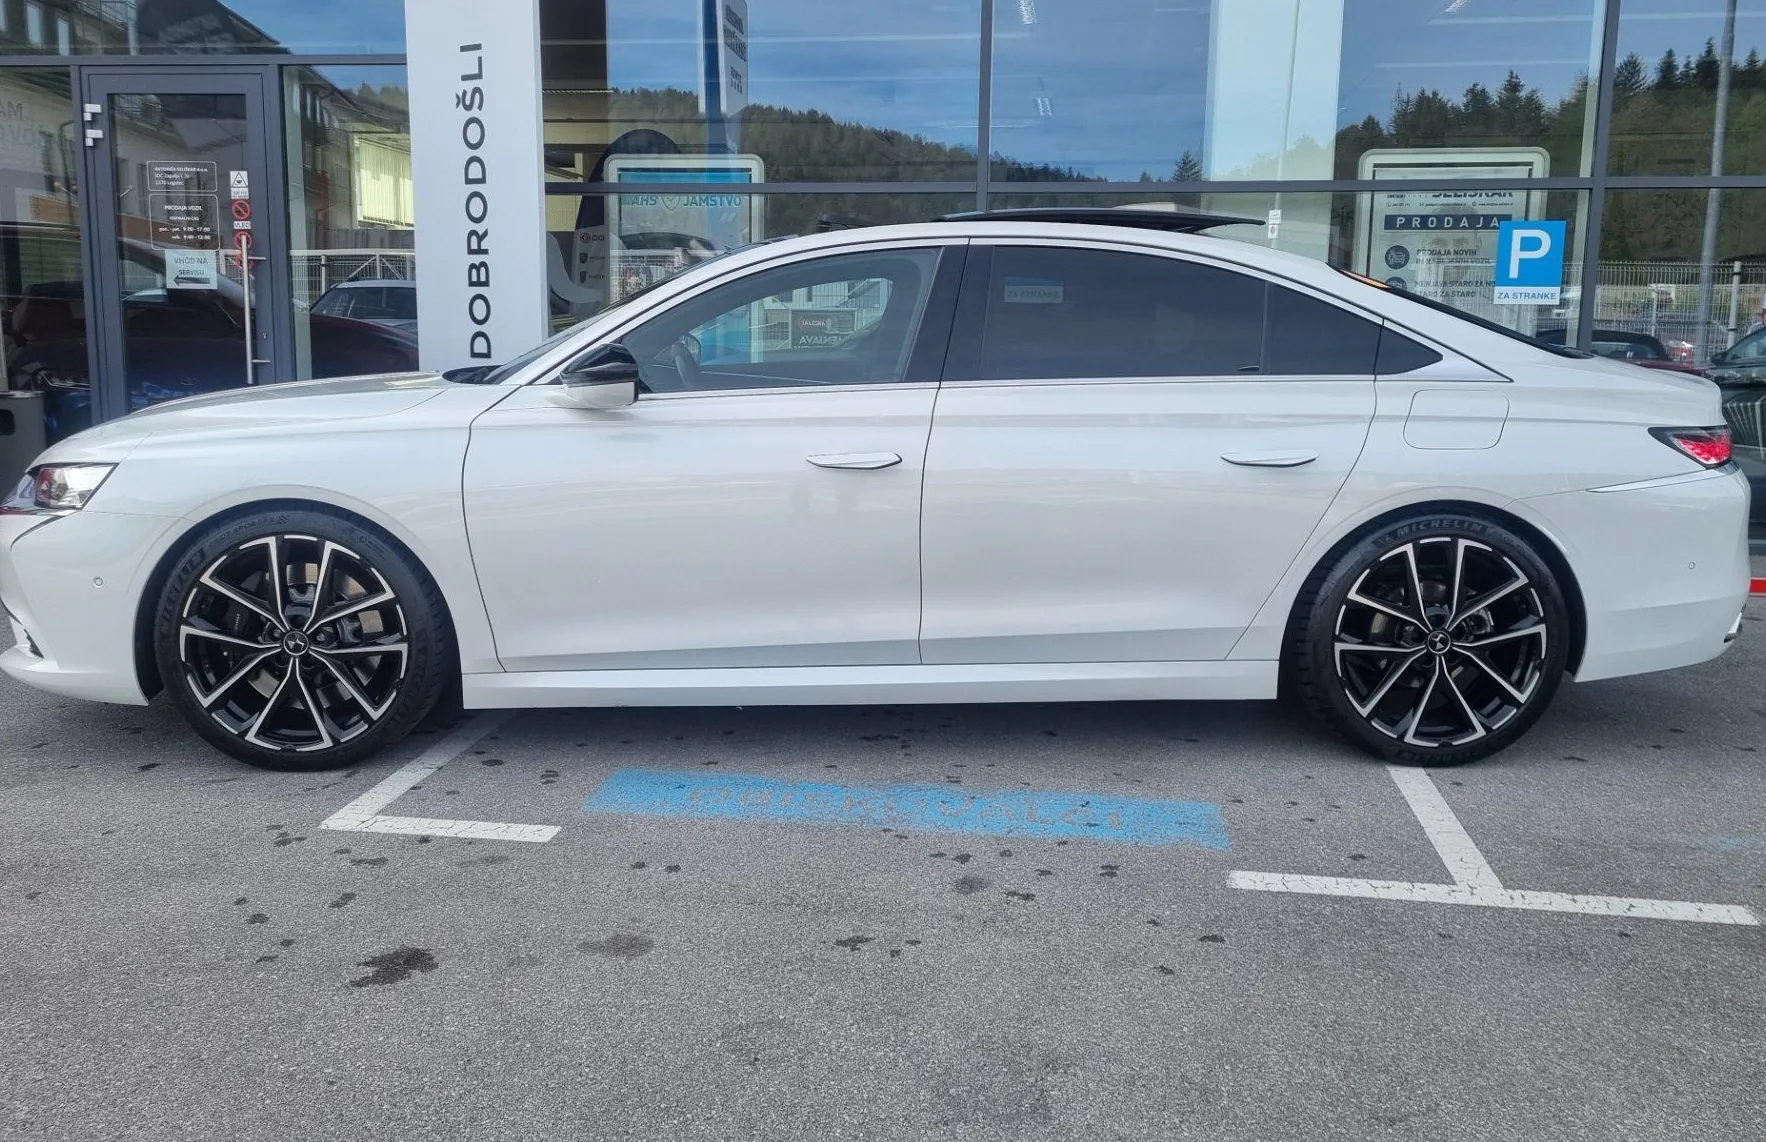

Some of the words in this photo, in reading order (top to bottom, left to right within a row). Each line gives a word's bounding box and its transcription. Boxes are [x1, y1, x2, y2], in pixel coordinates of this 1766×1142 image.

[456, 43, 492, 358] DOBRODOŠLI
[631, 195, 657, 206] AHS
[683, 195, 742, 207] JAMSTVO
[1397, 216, 1499, 228] PRODAJA
[1509, 229, 1551, 279] P
[174, 257, 196, 265] VHOD
[197, 257, 209, 265] NA
[1512, 292, 1557, 300] STRANKE
[1397, 519, 1485, 538] MICHELIN
